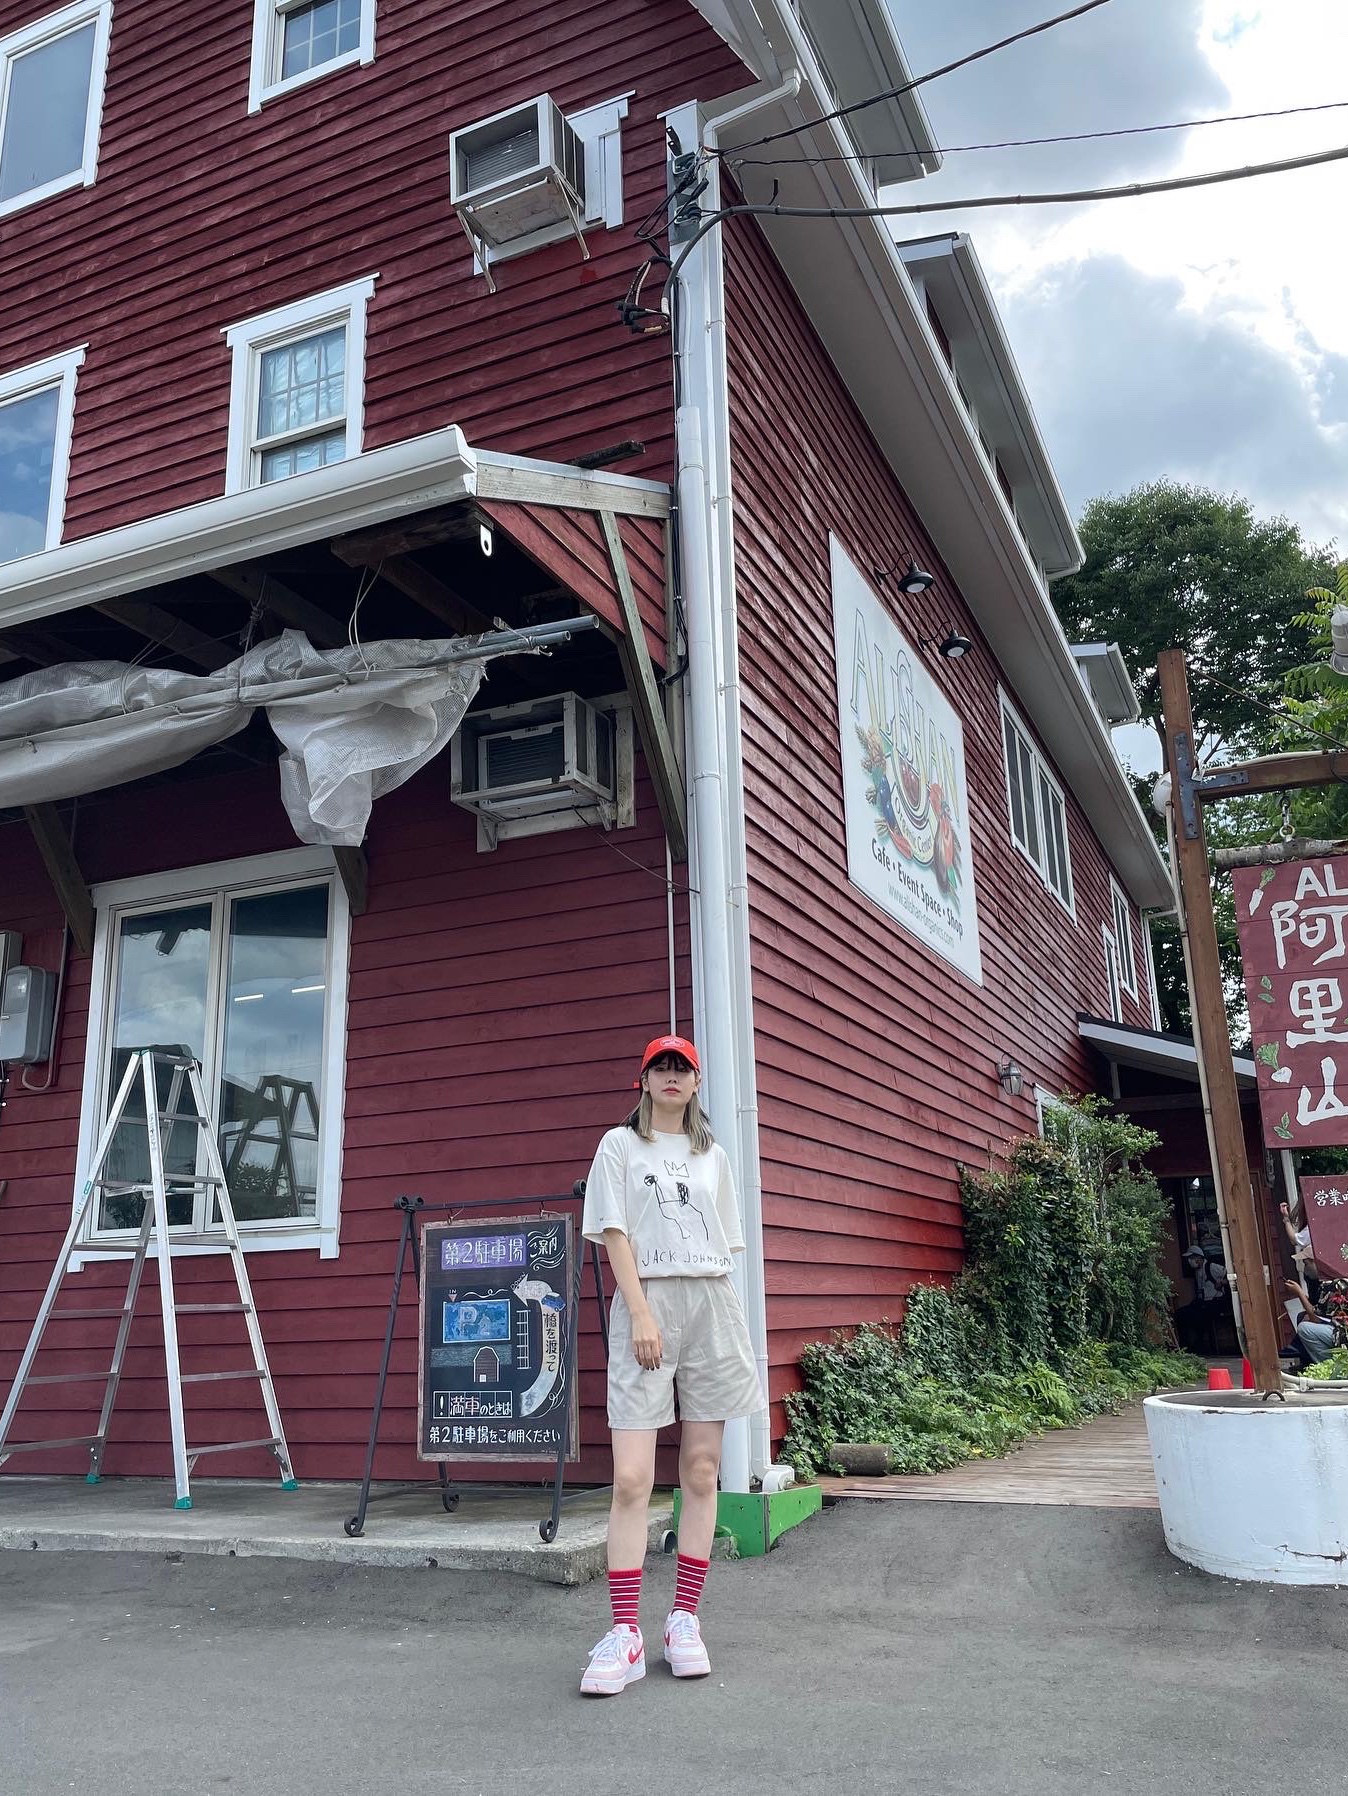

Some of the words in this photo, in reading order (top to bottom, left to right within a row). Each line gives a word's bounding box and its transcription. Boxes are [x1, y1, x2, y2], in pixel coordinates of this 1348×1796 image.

[871, 838, 891, 872] Cafe
[898, 861, 920, 899] Event
[920, 883, 942, 918] Space
[946, 907, 964, 940] Shop
[1270, 900, 1348, 1126] 阿里山
[445, 1238, 524, 1267] 第2駐車場
[529, 1236, 558, 1259] ご案内
[641, 1248, 677, 1267] JACK
[683, 1250, 732, 1267] JOHNSON
[543, 1312, 558, 1372] 橋を渡って
[429, 1425, 561, 1444] 第2駐車場をご利用ください
